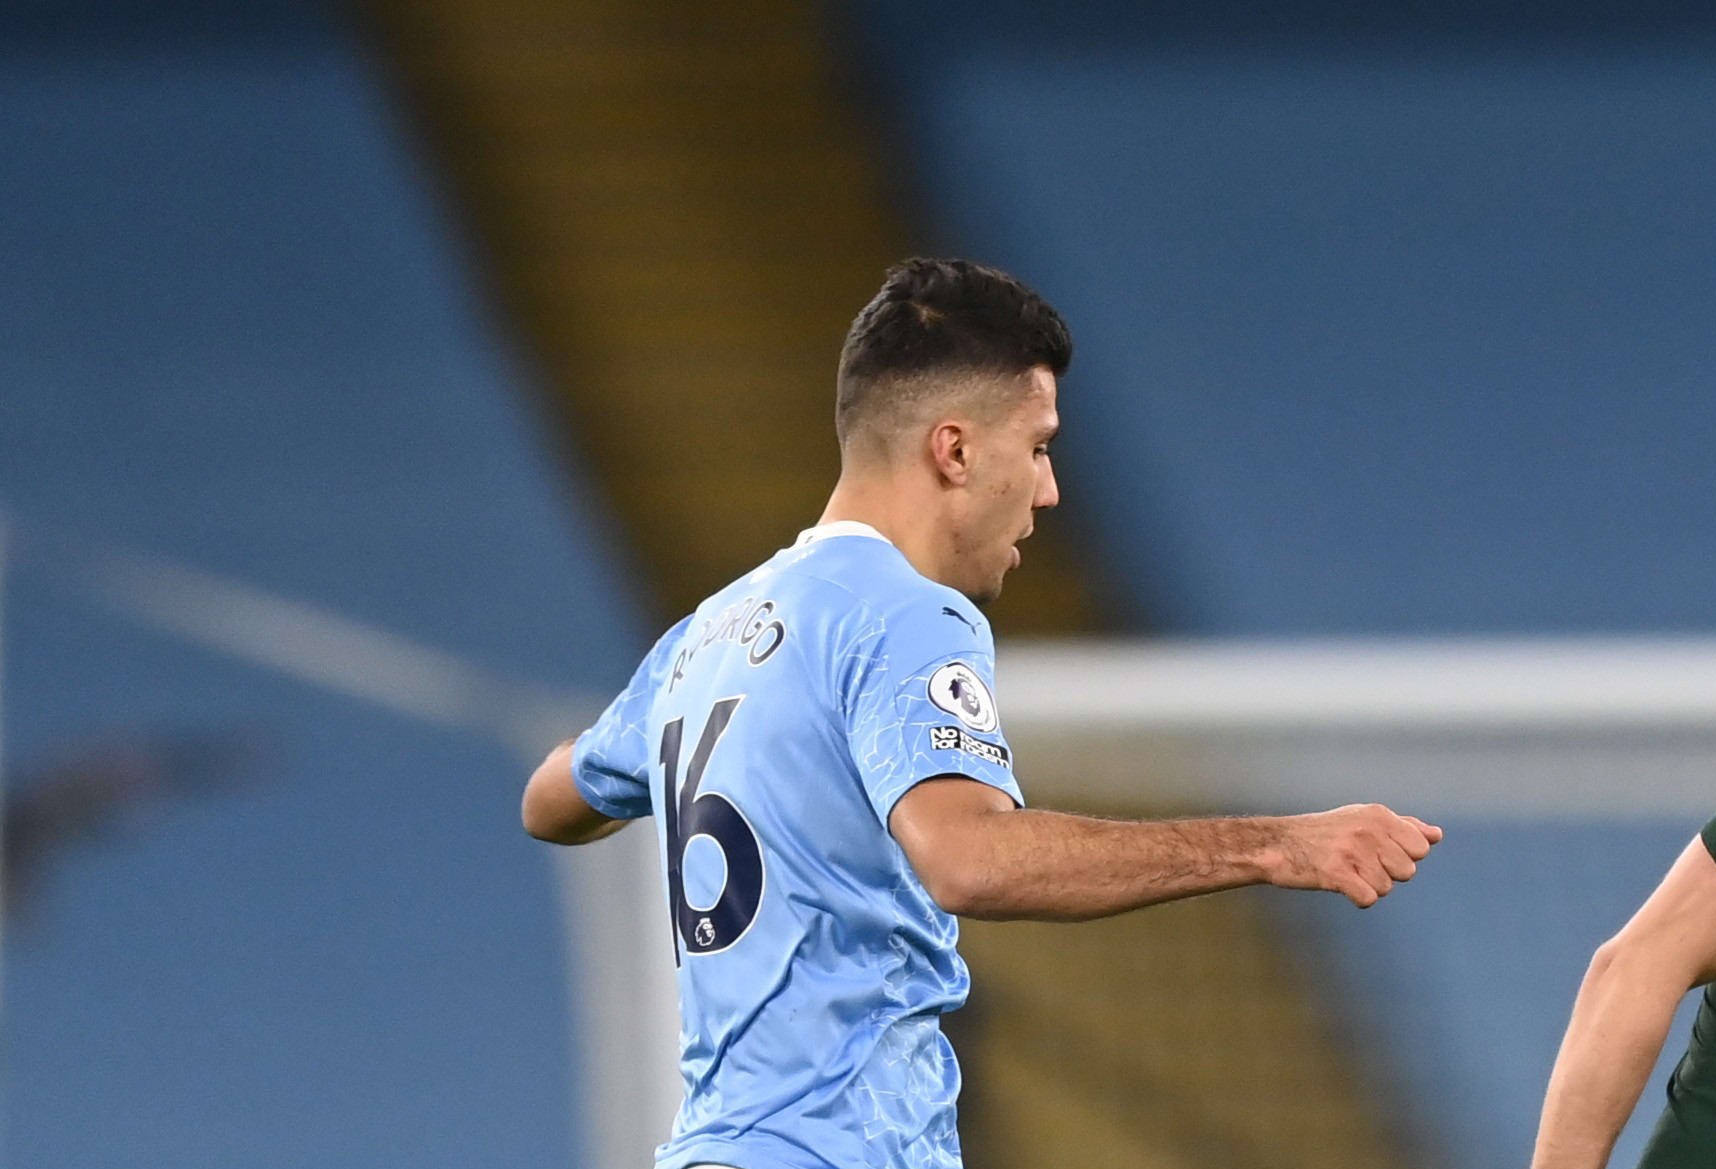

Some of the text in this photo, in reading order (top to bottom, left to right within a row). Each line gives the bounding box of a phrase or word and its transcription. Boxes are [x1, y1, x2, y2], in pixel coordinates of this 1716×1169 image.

[667, 598, 785, 694] RRIGO
[930, 726, 1002, 758] No room
[931, 738, 958, 750] for
[659, 695, 765, 968] 16
